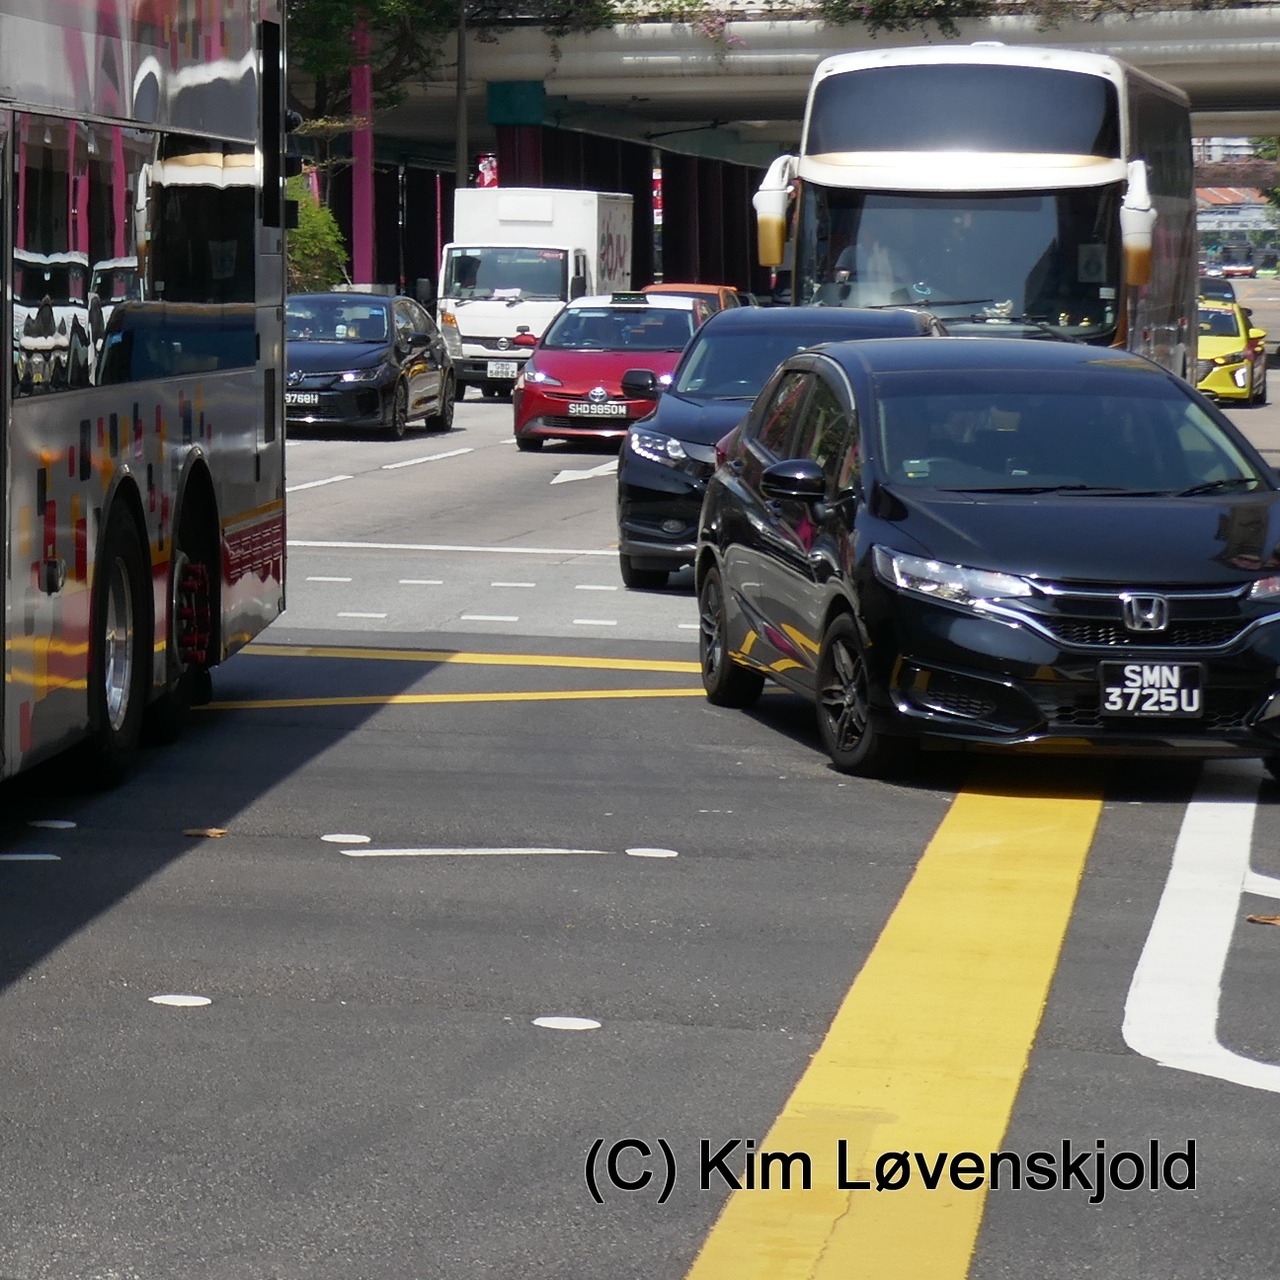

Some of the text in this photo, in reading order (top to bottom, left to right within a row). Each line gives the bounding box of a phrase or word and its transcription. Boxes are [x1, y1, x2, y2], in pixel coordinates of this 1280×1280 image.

[568, 403, 627, 415] SHD9850M
[1124, 664, 1180, 689] SMN
[1104, 687, 1200, 712] 3725U
